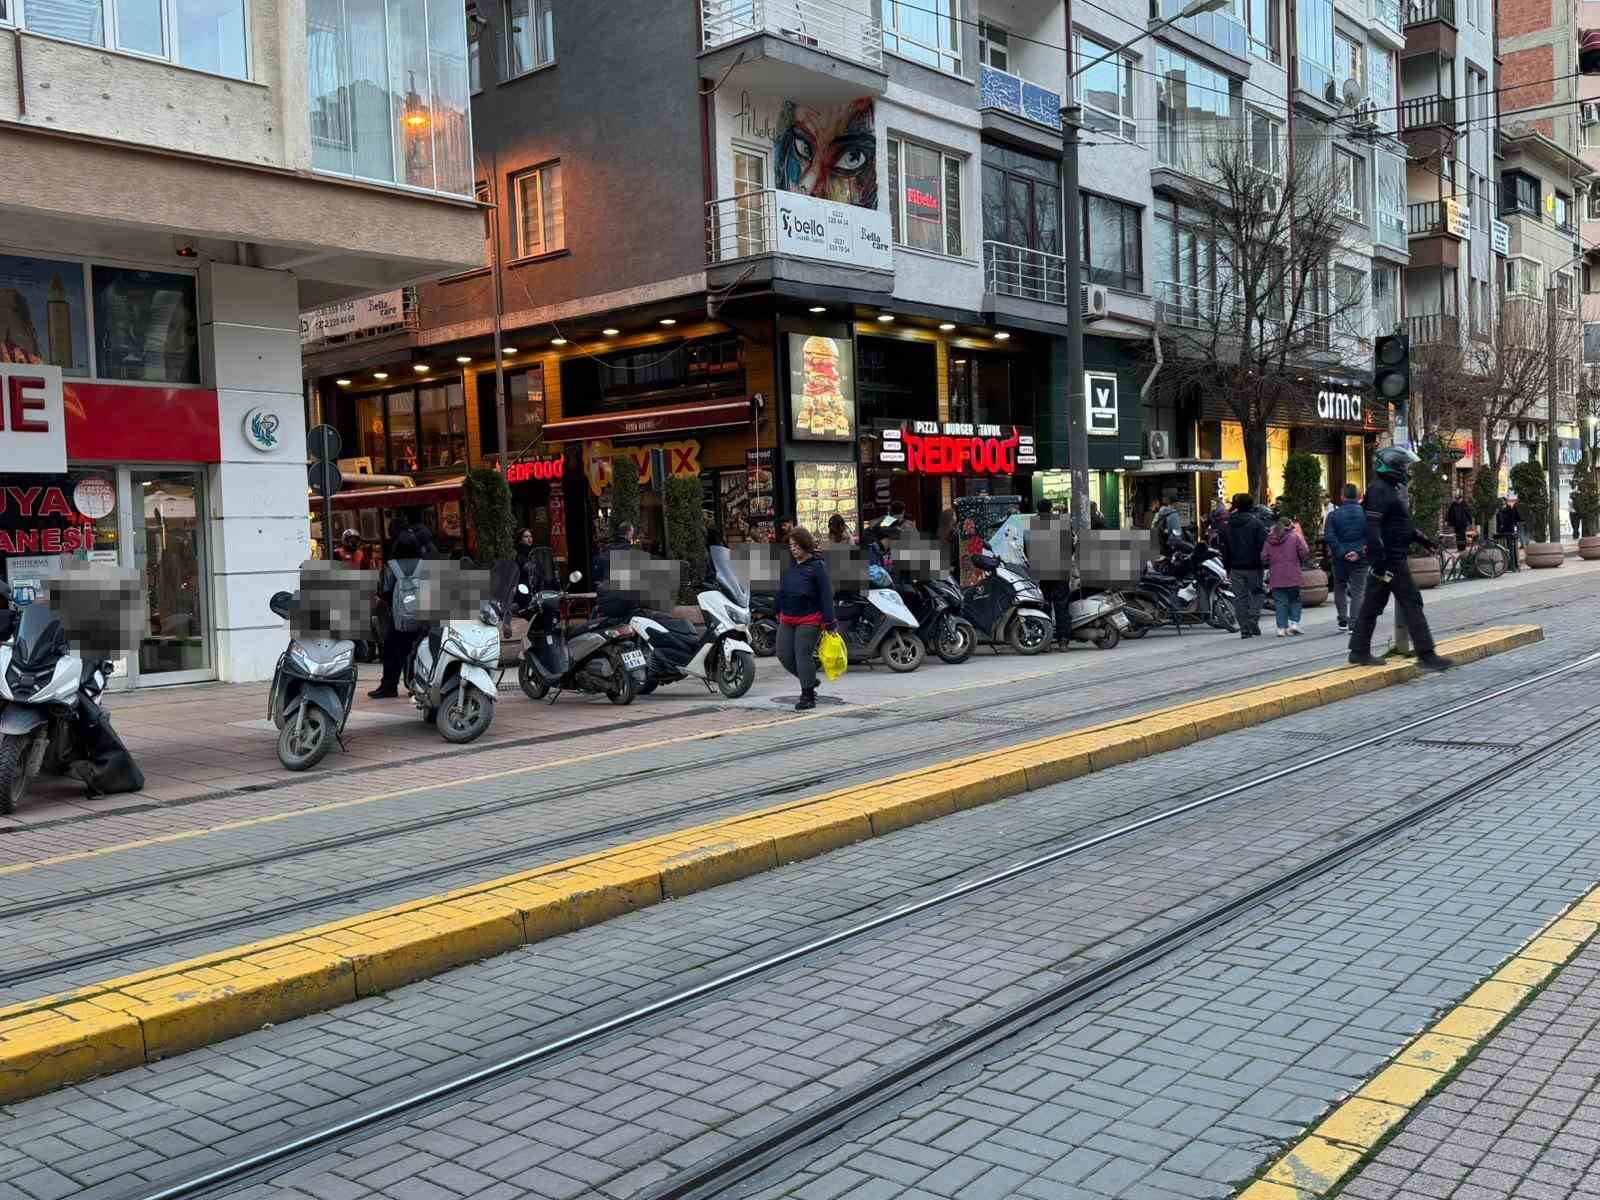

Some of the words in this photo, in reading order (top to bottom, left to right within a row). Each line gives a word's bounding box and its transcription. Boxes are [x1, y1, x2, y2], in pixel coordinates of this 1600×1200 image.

[794, 215, 825, 238] bella
[860, 227, 881, 242] Bella
[1096, 387, 1110, 408] V
[1317, 391, 1361, 421] arma
[915, 421, 939, 434] PIZZA
[943, 422, 974, 436] BURGER
[977, 424, 1002, 437] TAVUK
[903, 430, 1018, 474] REDFOOD
